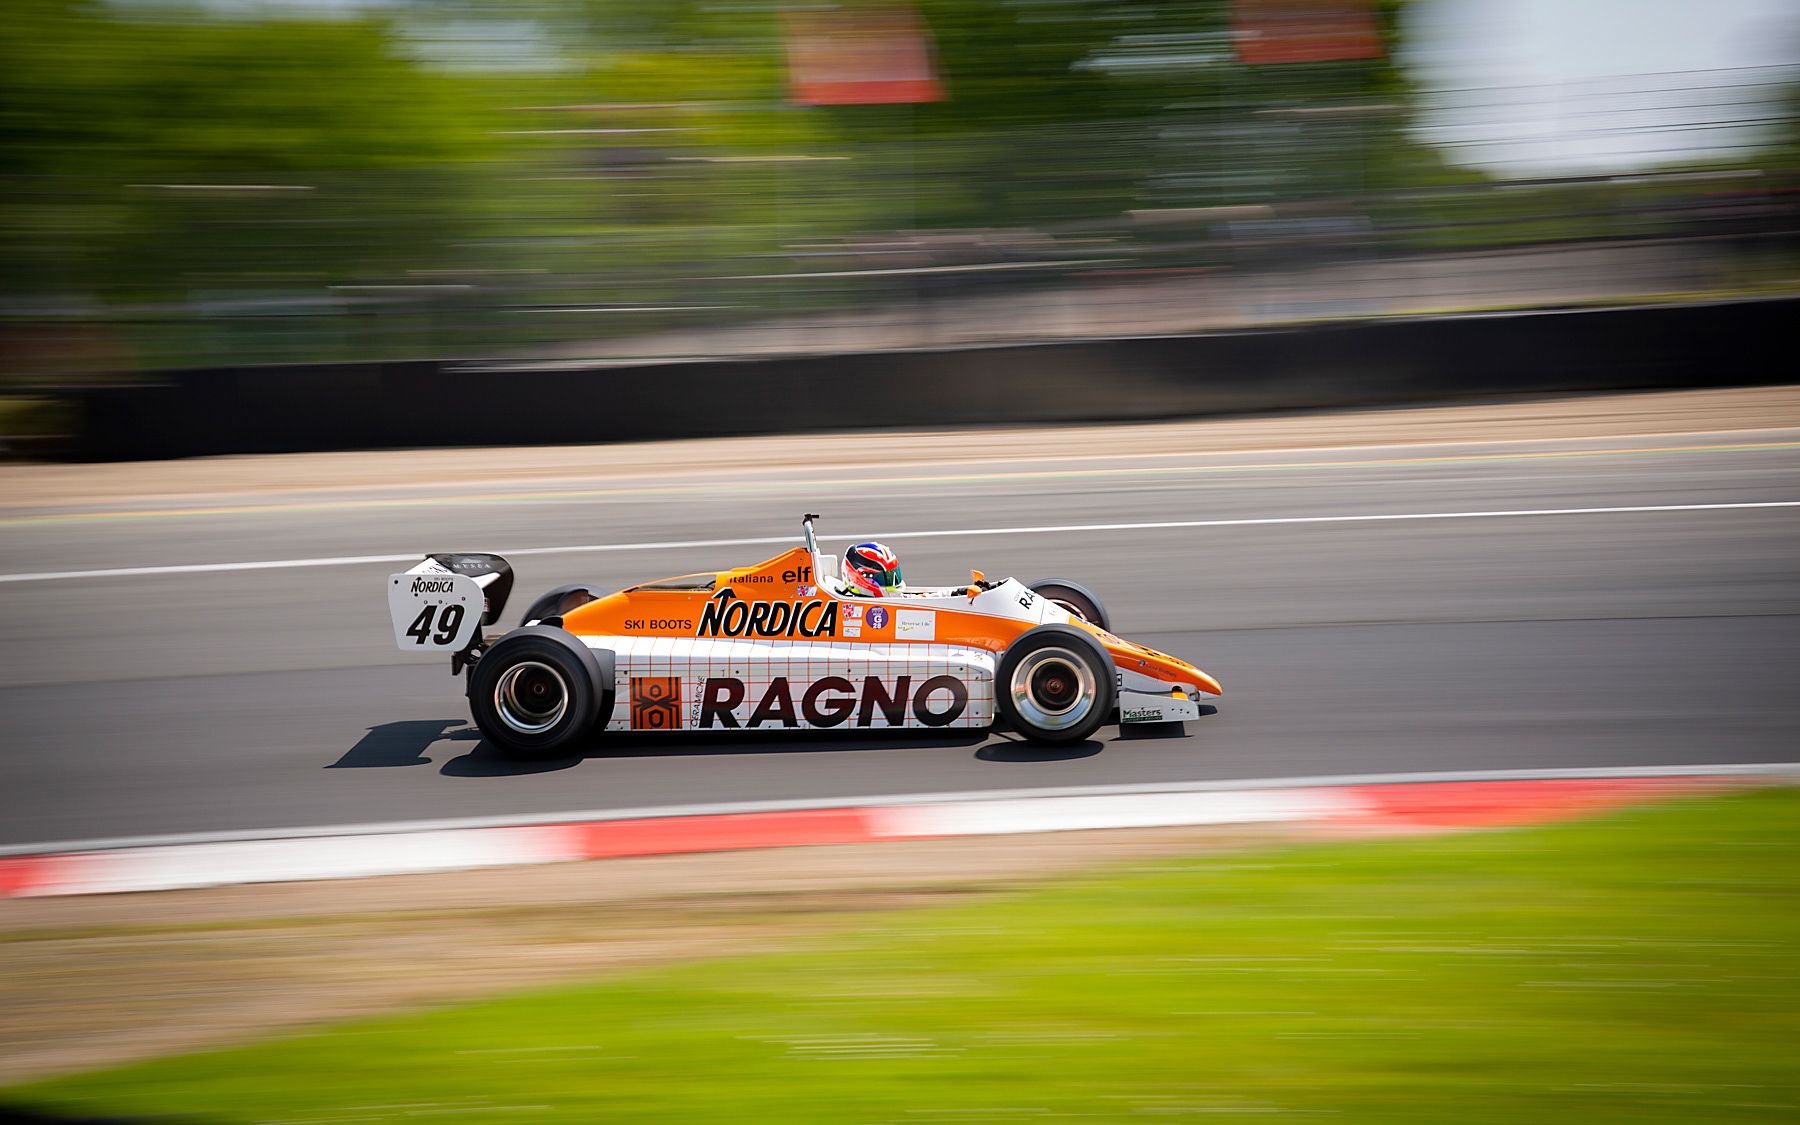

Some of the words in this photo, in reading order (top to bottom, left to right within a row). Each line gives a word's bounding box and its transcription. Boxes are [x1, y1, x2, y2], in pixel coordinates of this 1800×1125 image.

[411, 577, 454, 593] NORDICA
[782, 566, 811, 583] elf
[406, 604, 465, 646] 49
[624, 619, 645, 630] SKI
[650, 619, 692, 630] BOOTS
[697, 588, 838, 637] NORDICA
[691, 675, 705, 727] CERAMICHE
[699, 675, 968, 728] RAGNO
[1122, 708, 1162, 718] Masters
